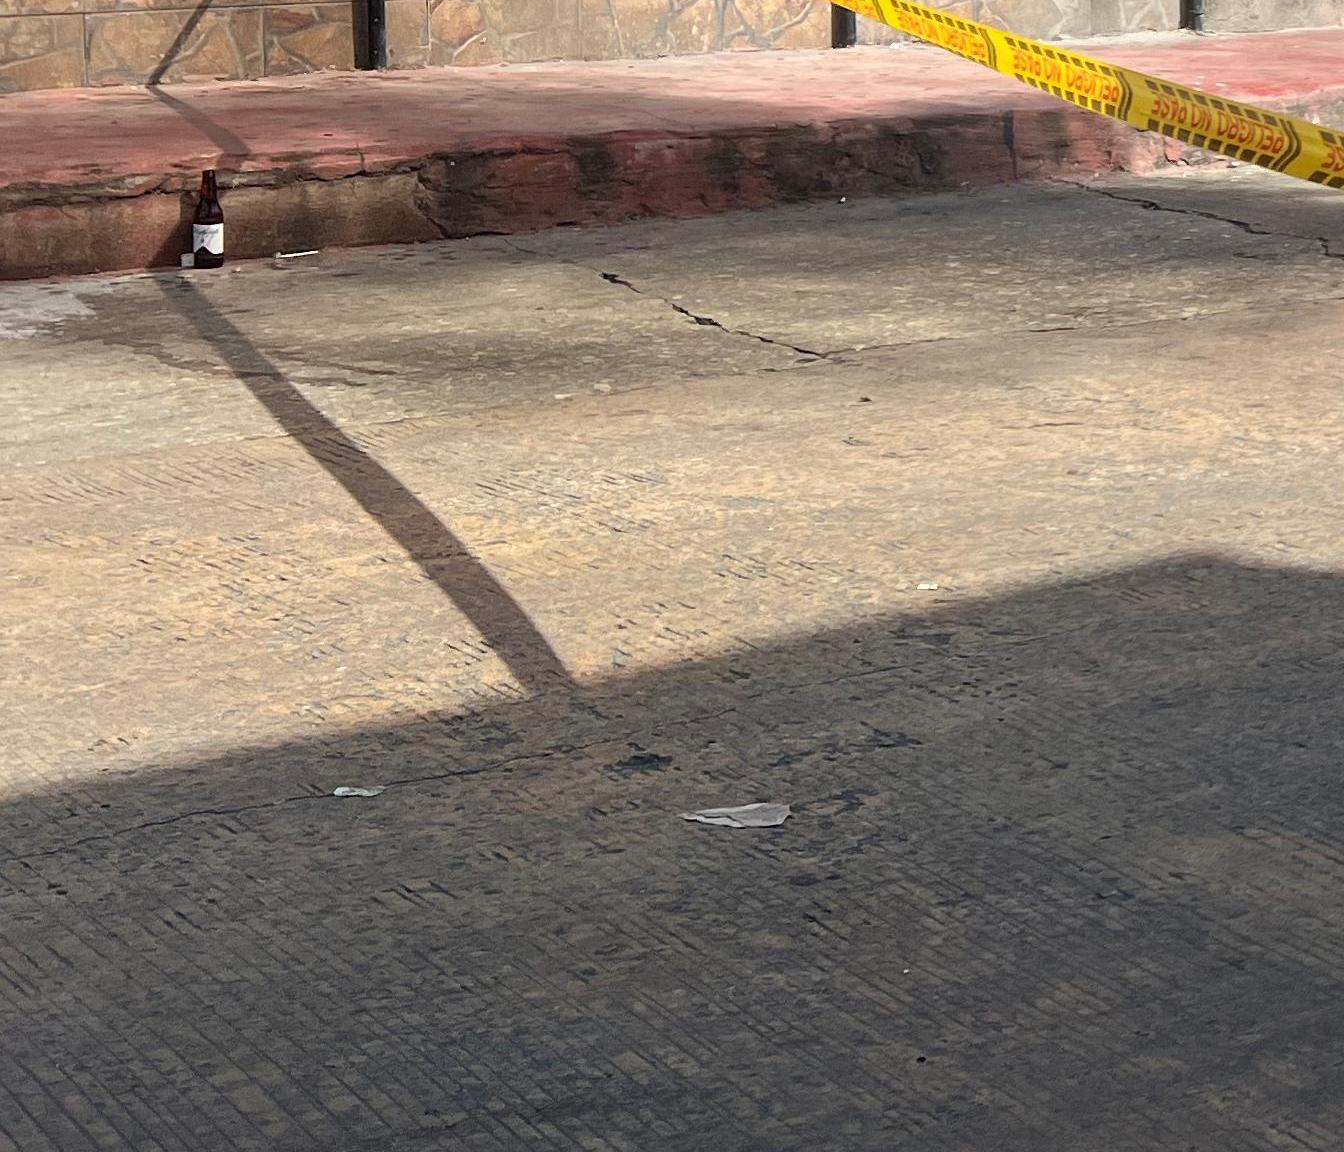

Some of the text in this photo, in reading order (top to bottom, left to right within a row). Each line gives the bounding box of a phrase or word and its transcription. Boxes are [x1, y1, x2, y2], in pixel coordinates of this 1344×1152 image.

[1013, 47, 1121, 103] PELIGRO NO PASE
[1151, 89, 1286, 155] PELIGRO NO PASE
